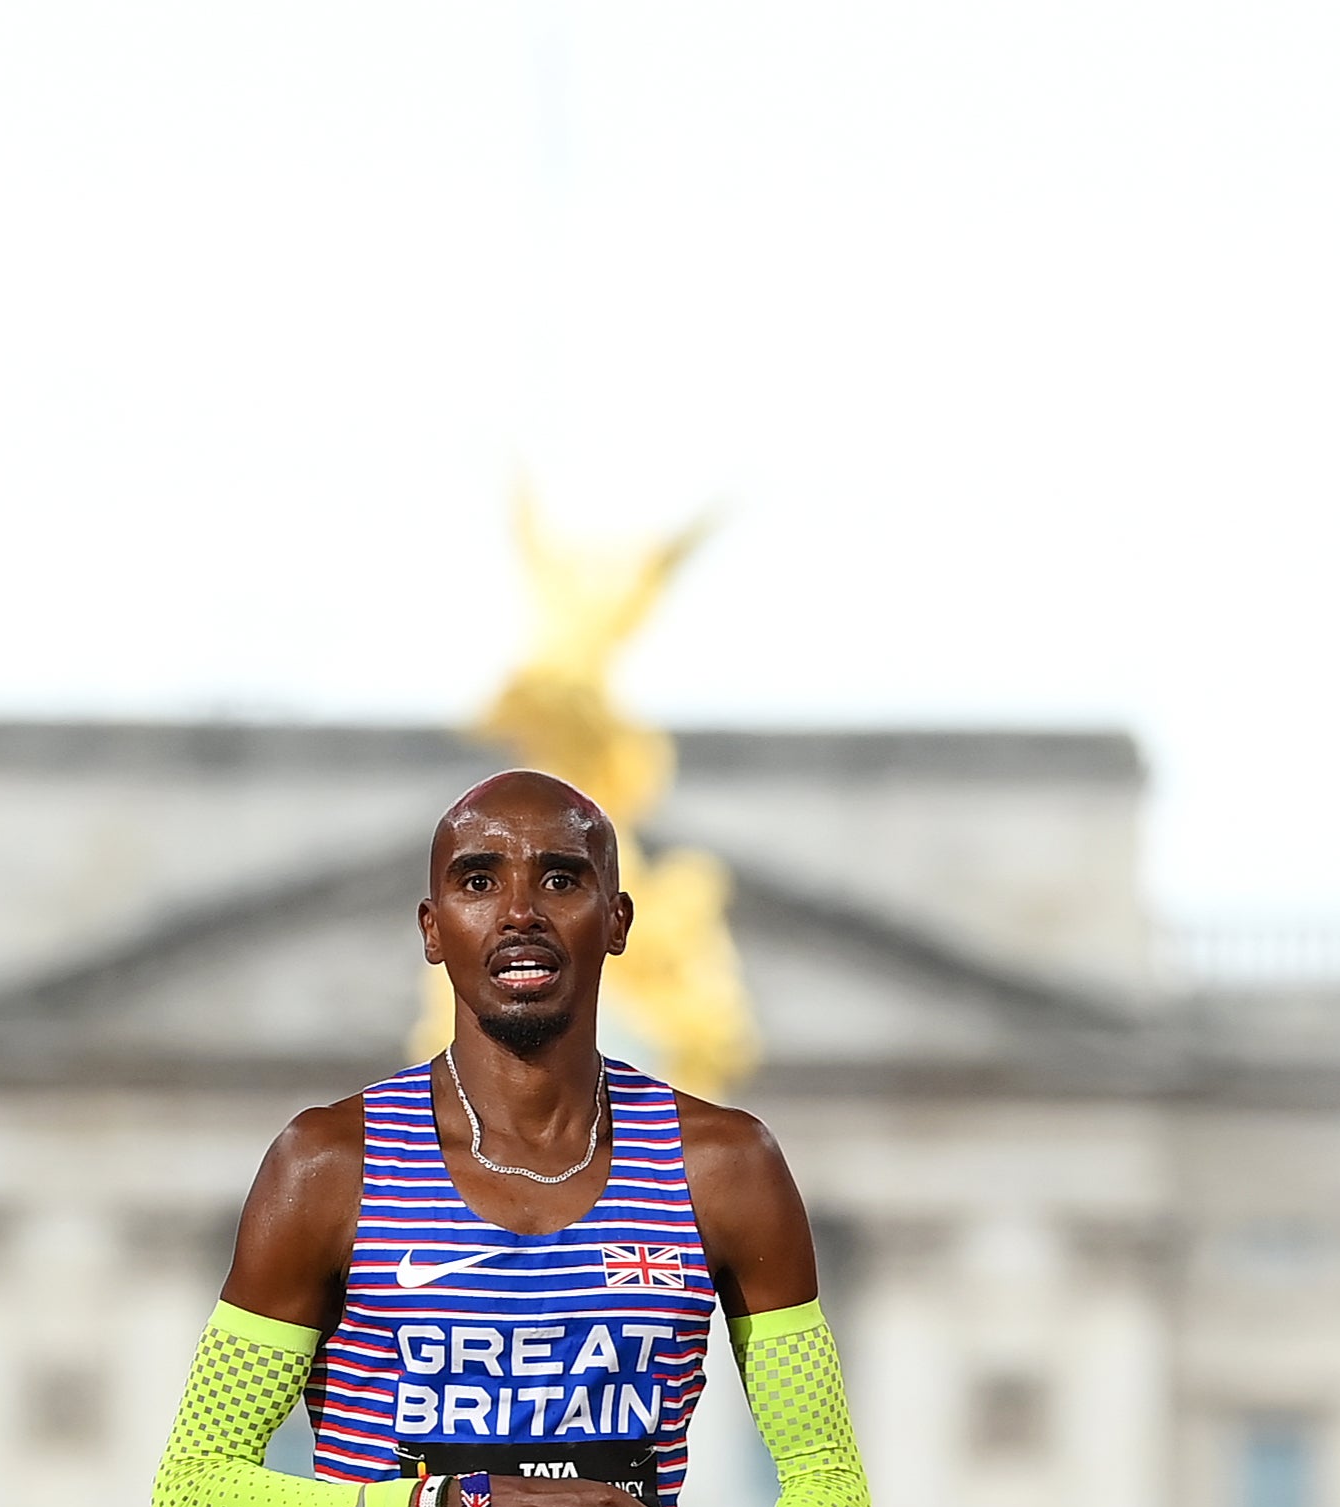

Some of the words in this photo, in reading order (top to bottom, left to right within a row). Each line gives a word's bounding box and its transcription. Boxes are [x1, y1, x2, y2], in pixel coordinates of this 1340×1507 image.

[397, 1324, 674, 1377] GREAT
[394, 1382, 661, 1437] BRITAIN
[519, 1461, 579, 1479] TATA
